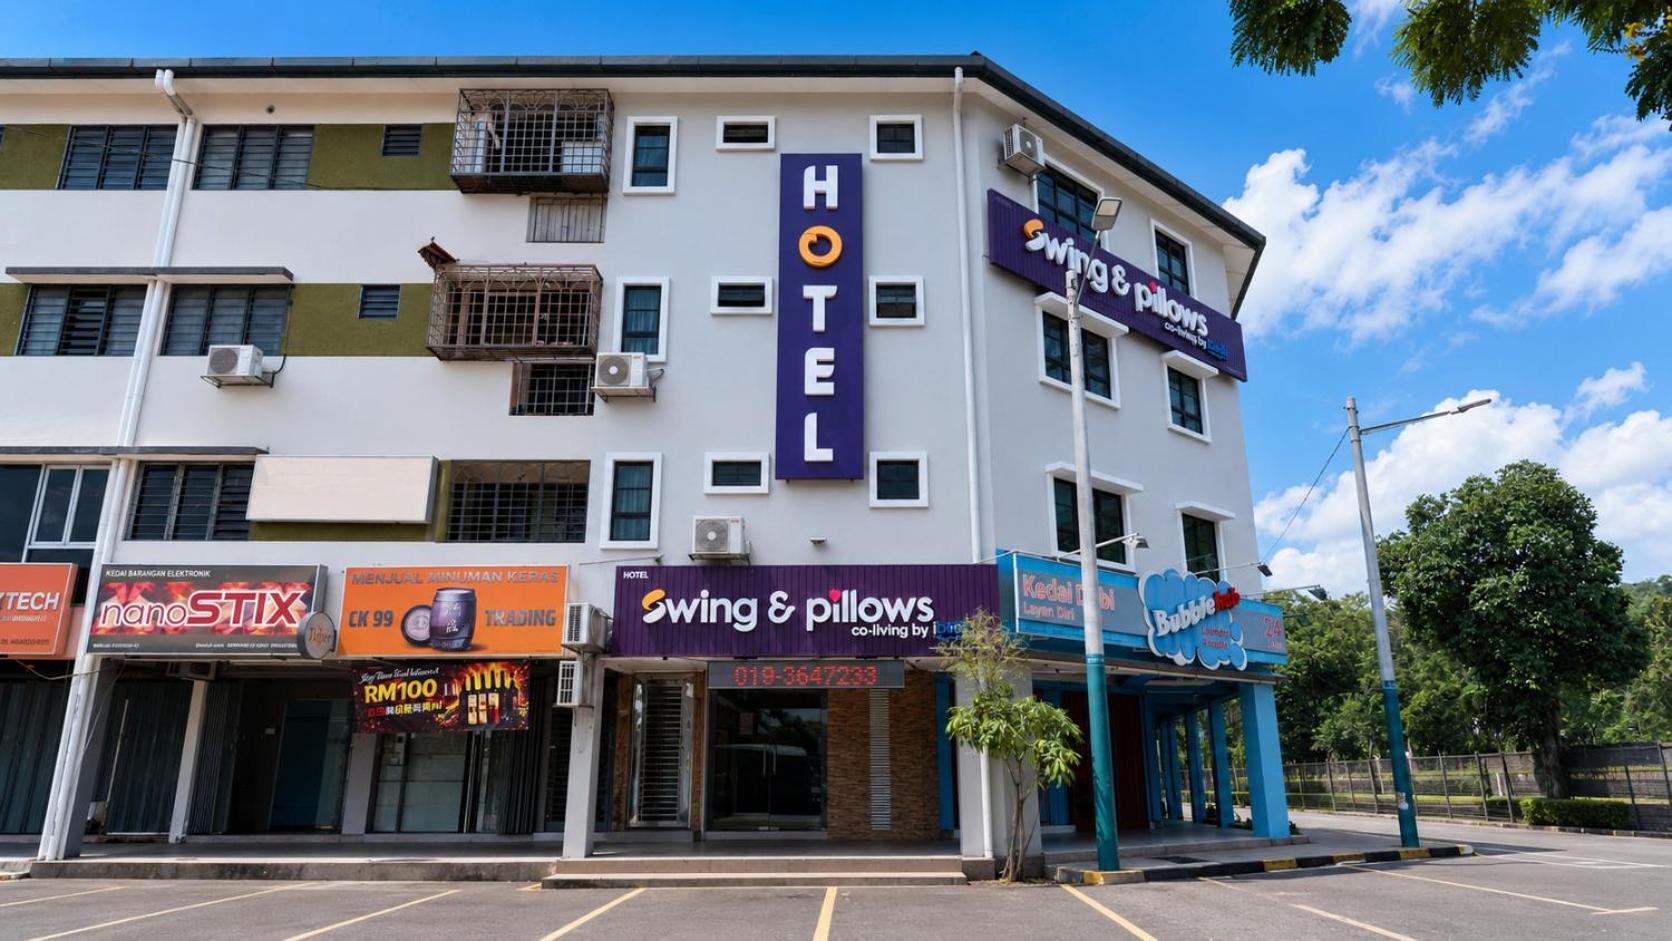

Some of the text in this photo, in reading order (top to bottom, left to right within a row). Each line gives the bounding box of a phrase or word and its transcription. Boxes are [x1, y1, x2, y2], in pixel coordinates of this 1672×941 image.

[1023, 219, 1208, 337] Swing & pillows
[799, 165, 842, 461] HOTEL
[351, 571, 560, 585] MENJUAL MINUMAN KERAS
[623, 571, 649, 579] HOTEL
[1023, 574, 1116, 611] Kedai Dbi
[99, 588, 305, 628] nanoSTIX
[348, 609, 557, 627] CK 99 TRADING
[641, 588, 758, 632] Swing
[768, 590, 796, 624] &
[806, 588, 935, 631] pillows
[1023, 601, 1054, 618] Layan
[851, 623, 909, 639] co-living
[912, 623, 929, 638] by
[1264, 617, 1281, 637] 24
[735, 666, 878, 687] 019-3647233
[364, 678, 438, 704] RM100
